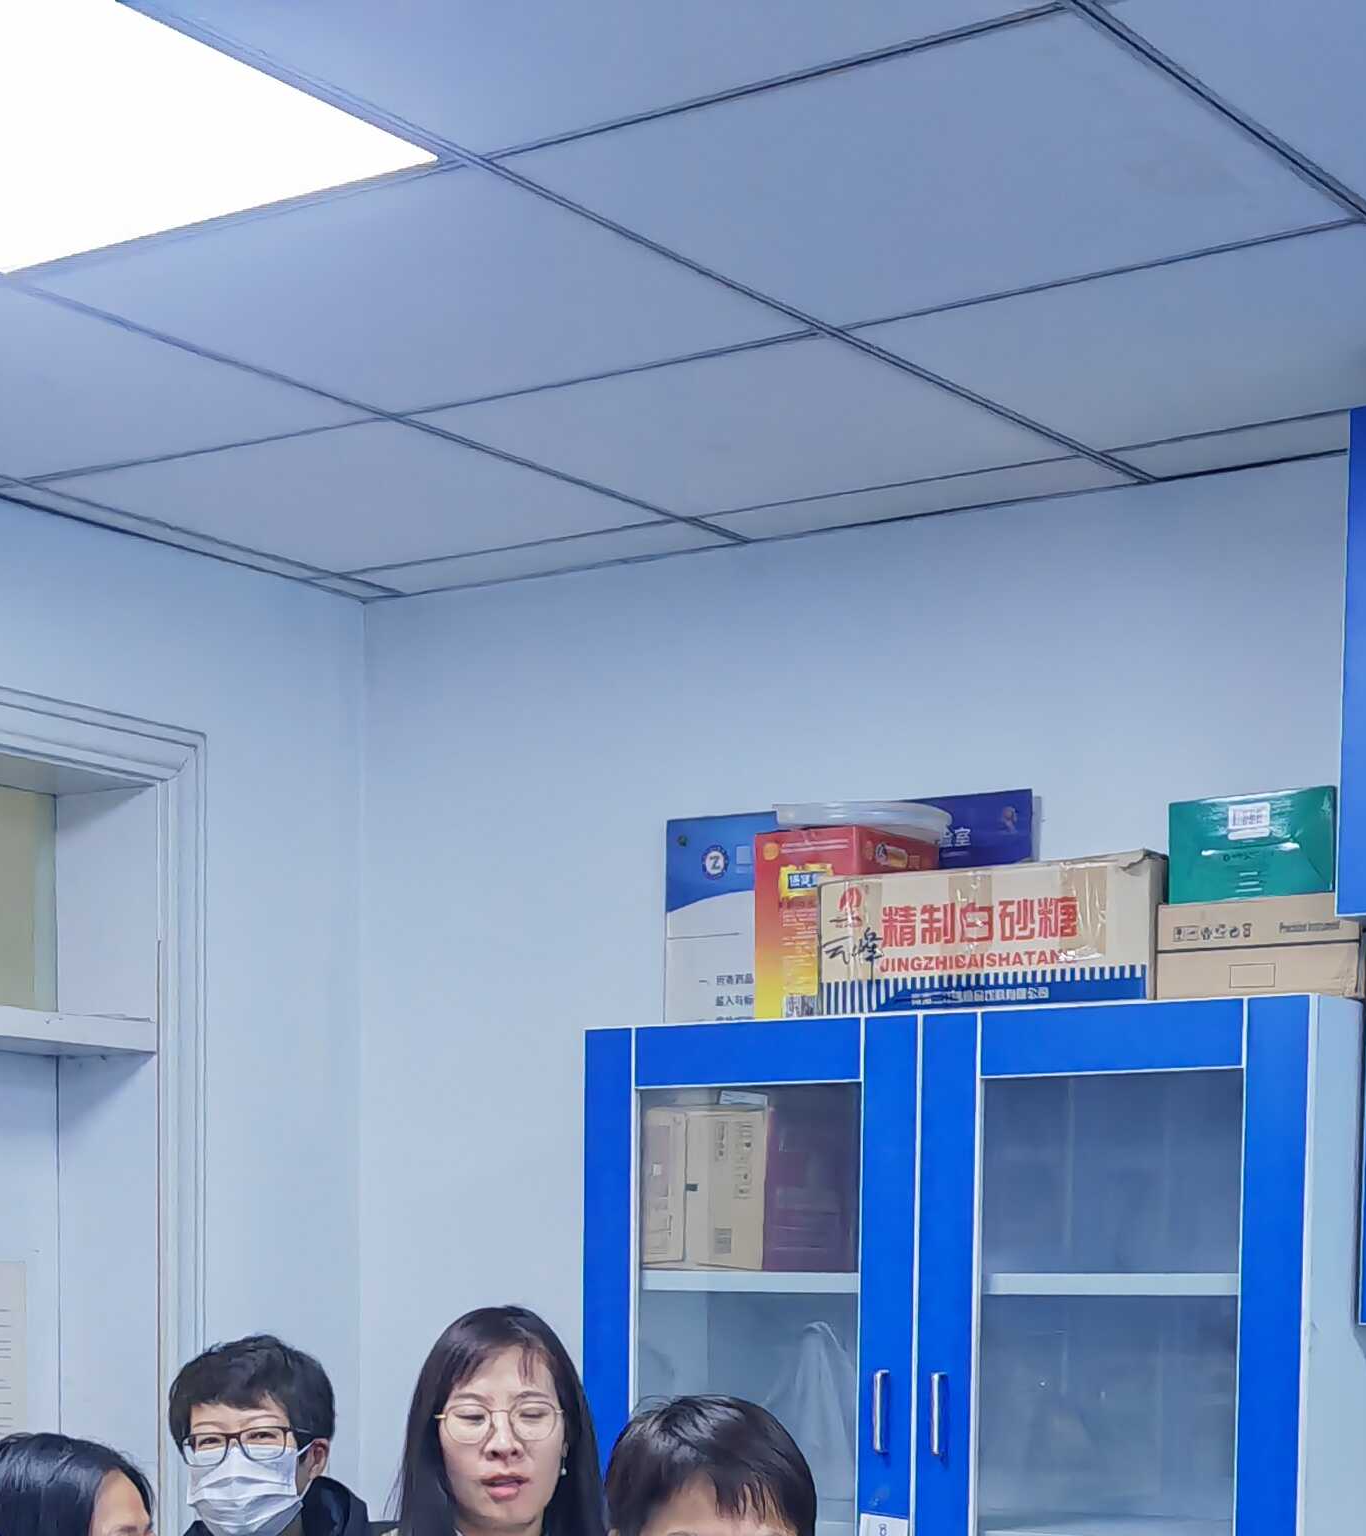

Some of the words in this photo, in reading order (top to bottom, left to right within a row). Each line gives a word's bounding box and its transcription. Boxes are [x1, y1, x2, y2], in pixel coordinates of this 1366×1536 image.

[881, 896, 1078, 948] 精制白砂糖
[879, 949, 1075, 973] JINGZHIBAISHATAN
